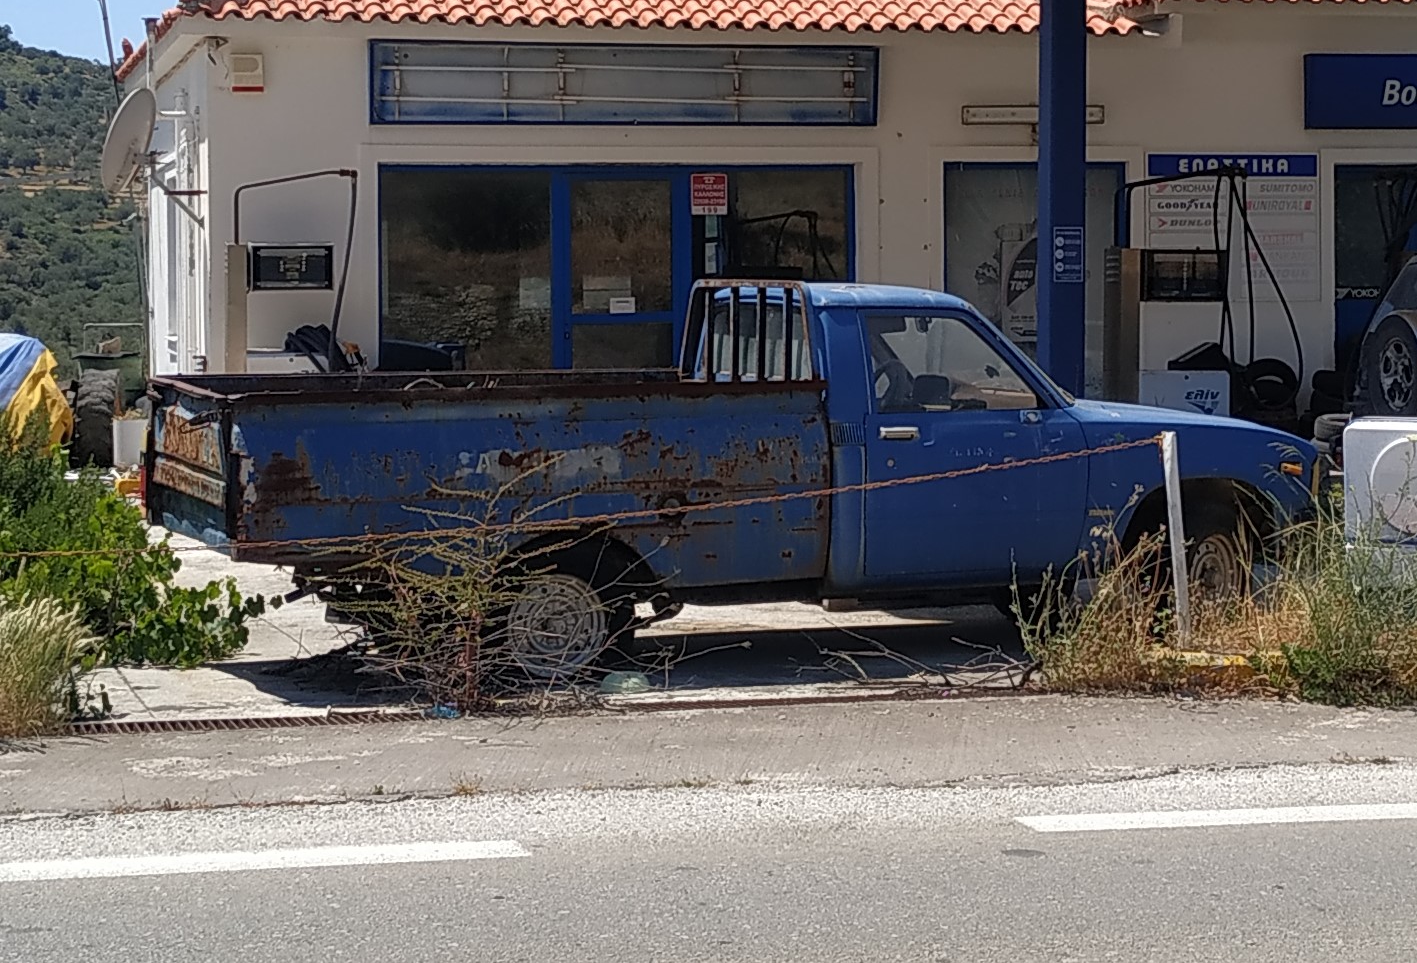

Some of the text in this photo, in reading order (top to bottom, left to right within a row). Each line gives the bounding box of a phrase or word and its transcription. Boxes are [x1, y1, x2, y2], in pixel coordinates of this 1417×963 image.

[1170, 184, 1215, 193] YOKOHAM
[1260, 184, 1314, 193] SUMITOMO
[1157, 200, 1218, 210] GOODYEA
[1253, 200, 1302, 211] UNIROYAL
